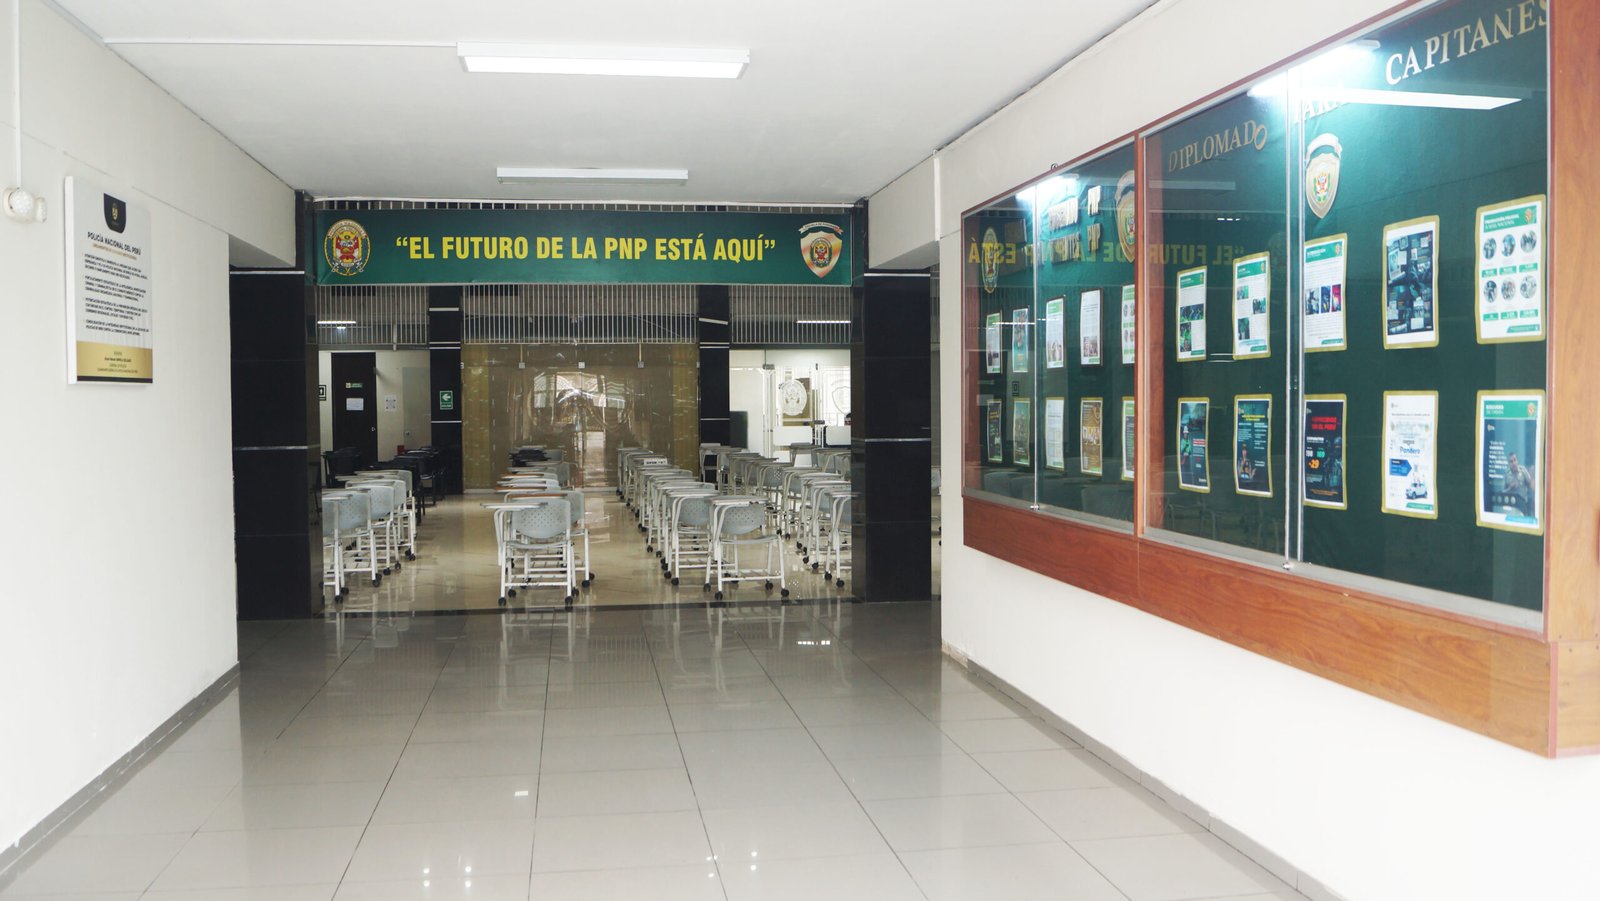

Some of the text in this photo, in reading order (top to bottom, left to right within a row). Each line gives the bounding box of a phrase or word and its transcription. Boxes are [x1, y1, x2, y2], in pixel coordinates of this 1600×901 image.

[1168, 119, 1268, 173] DIPLOMADO
[104, 237, 124, 250] NACIONAL
[396, 233, 776, 263] “EL FUTURO DE LA PNP ESTÁ AQUÍ”
